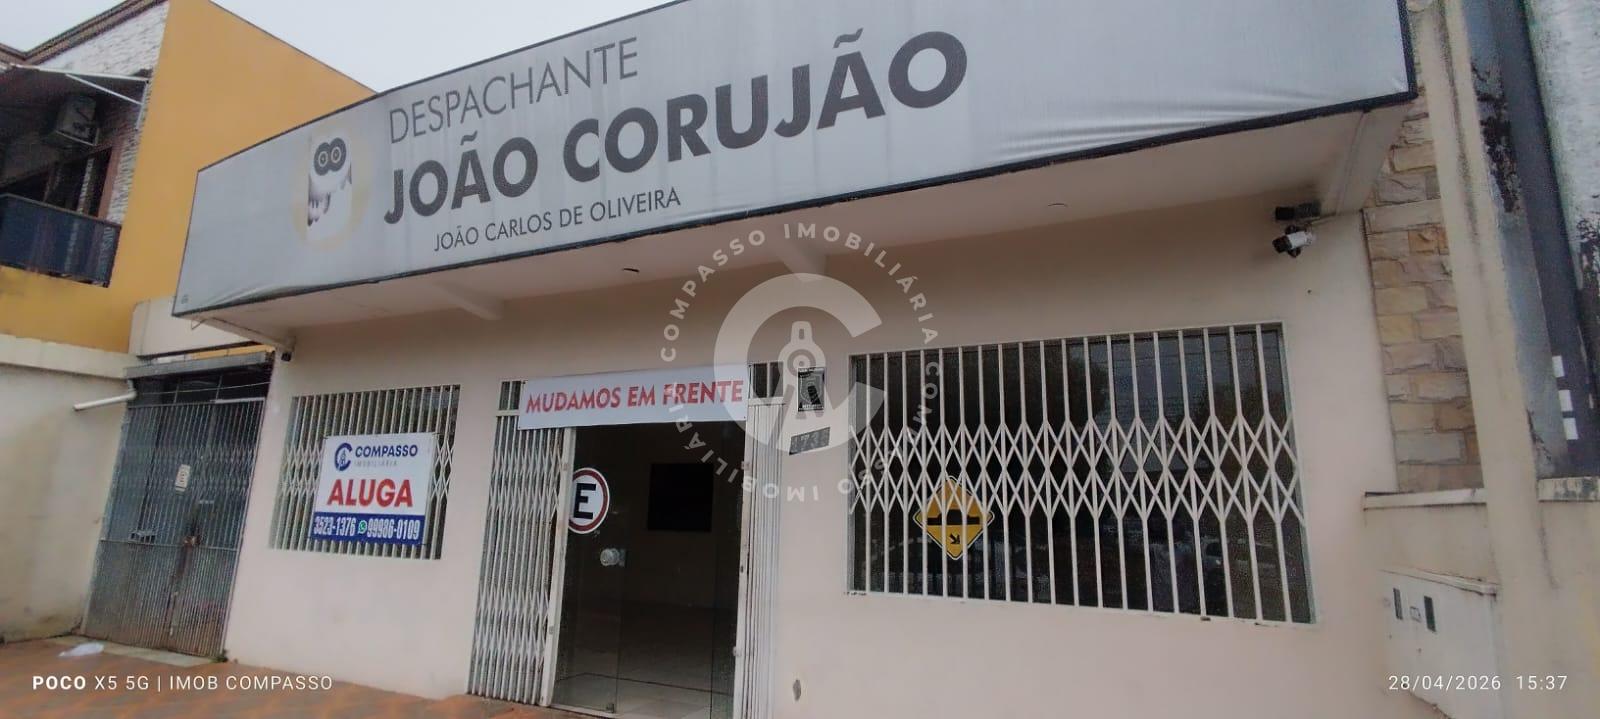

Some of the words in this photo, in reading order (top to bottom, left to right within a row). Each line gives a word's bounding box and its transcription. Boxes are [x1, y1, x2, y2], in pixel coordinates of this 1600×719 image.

[389, 36, 638, 145] DESPACHANTE
[383, 130, 538, 225] JOÃO
[563, 27, 968, 183] CORUJÃO
[434, 224, 479, 252] JOÃO
[484, 211, 552, 242] CARLOS
[559, 205, 583, 228] DE
[590, 186, 681, 222] OLIVEIRA
[525, 386, 621, 415] MUDAMOS
[627, 384, 655, 407] EM
[662, 380, 744, 406] FRENTE
[355, 444, 418, 458] COMPASSO
[326, 478, 413, 508] ALUGA
[573, 482, 596, 519] E
[313, 515, 357, 537] 3523-1376
[367, 518, 421, 540] 99986-0109
